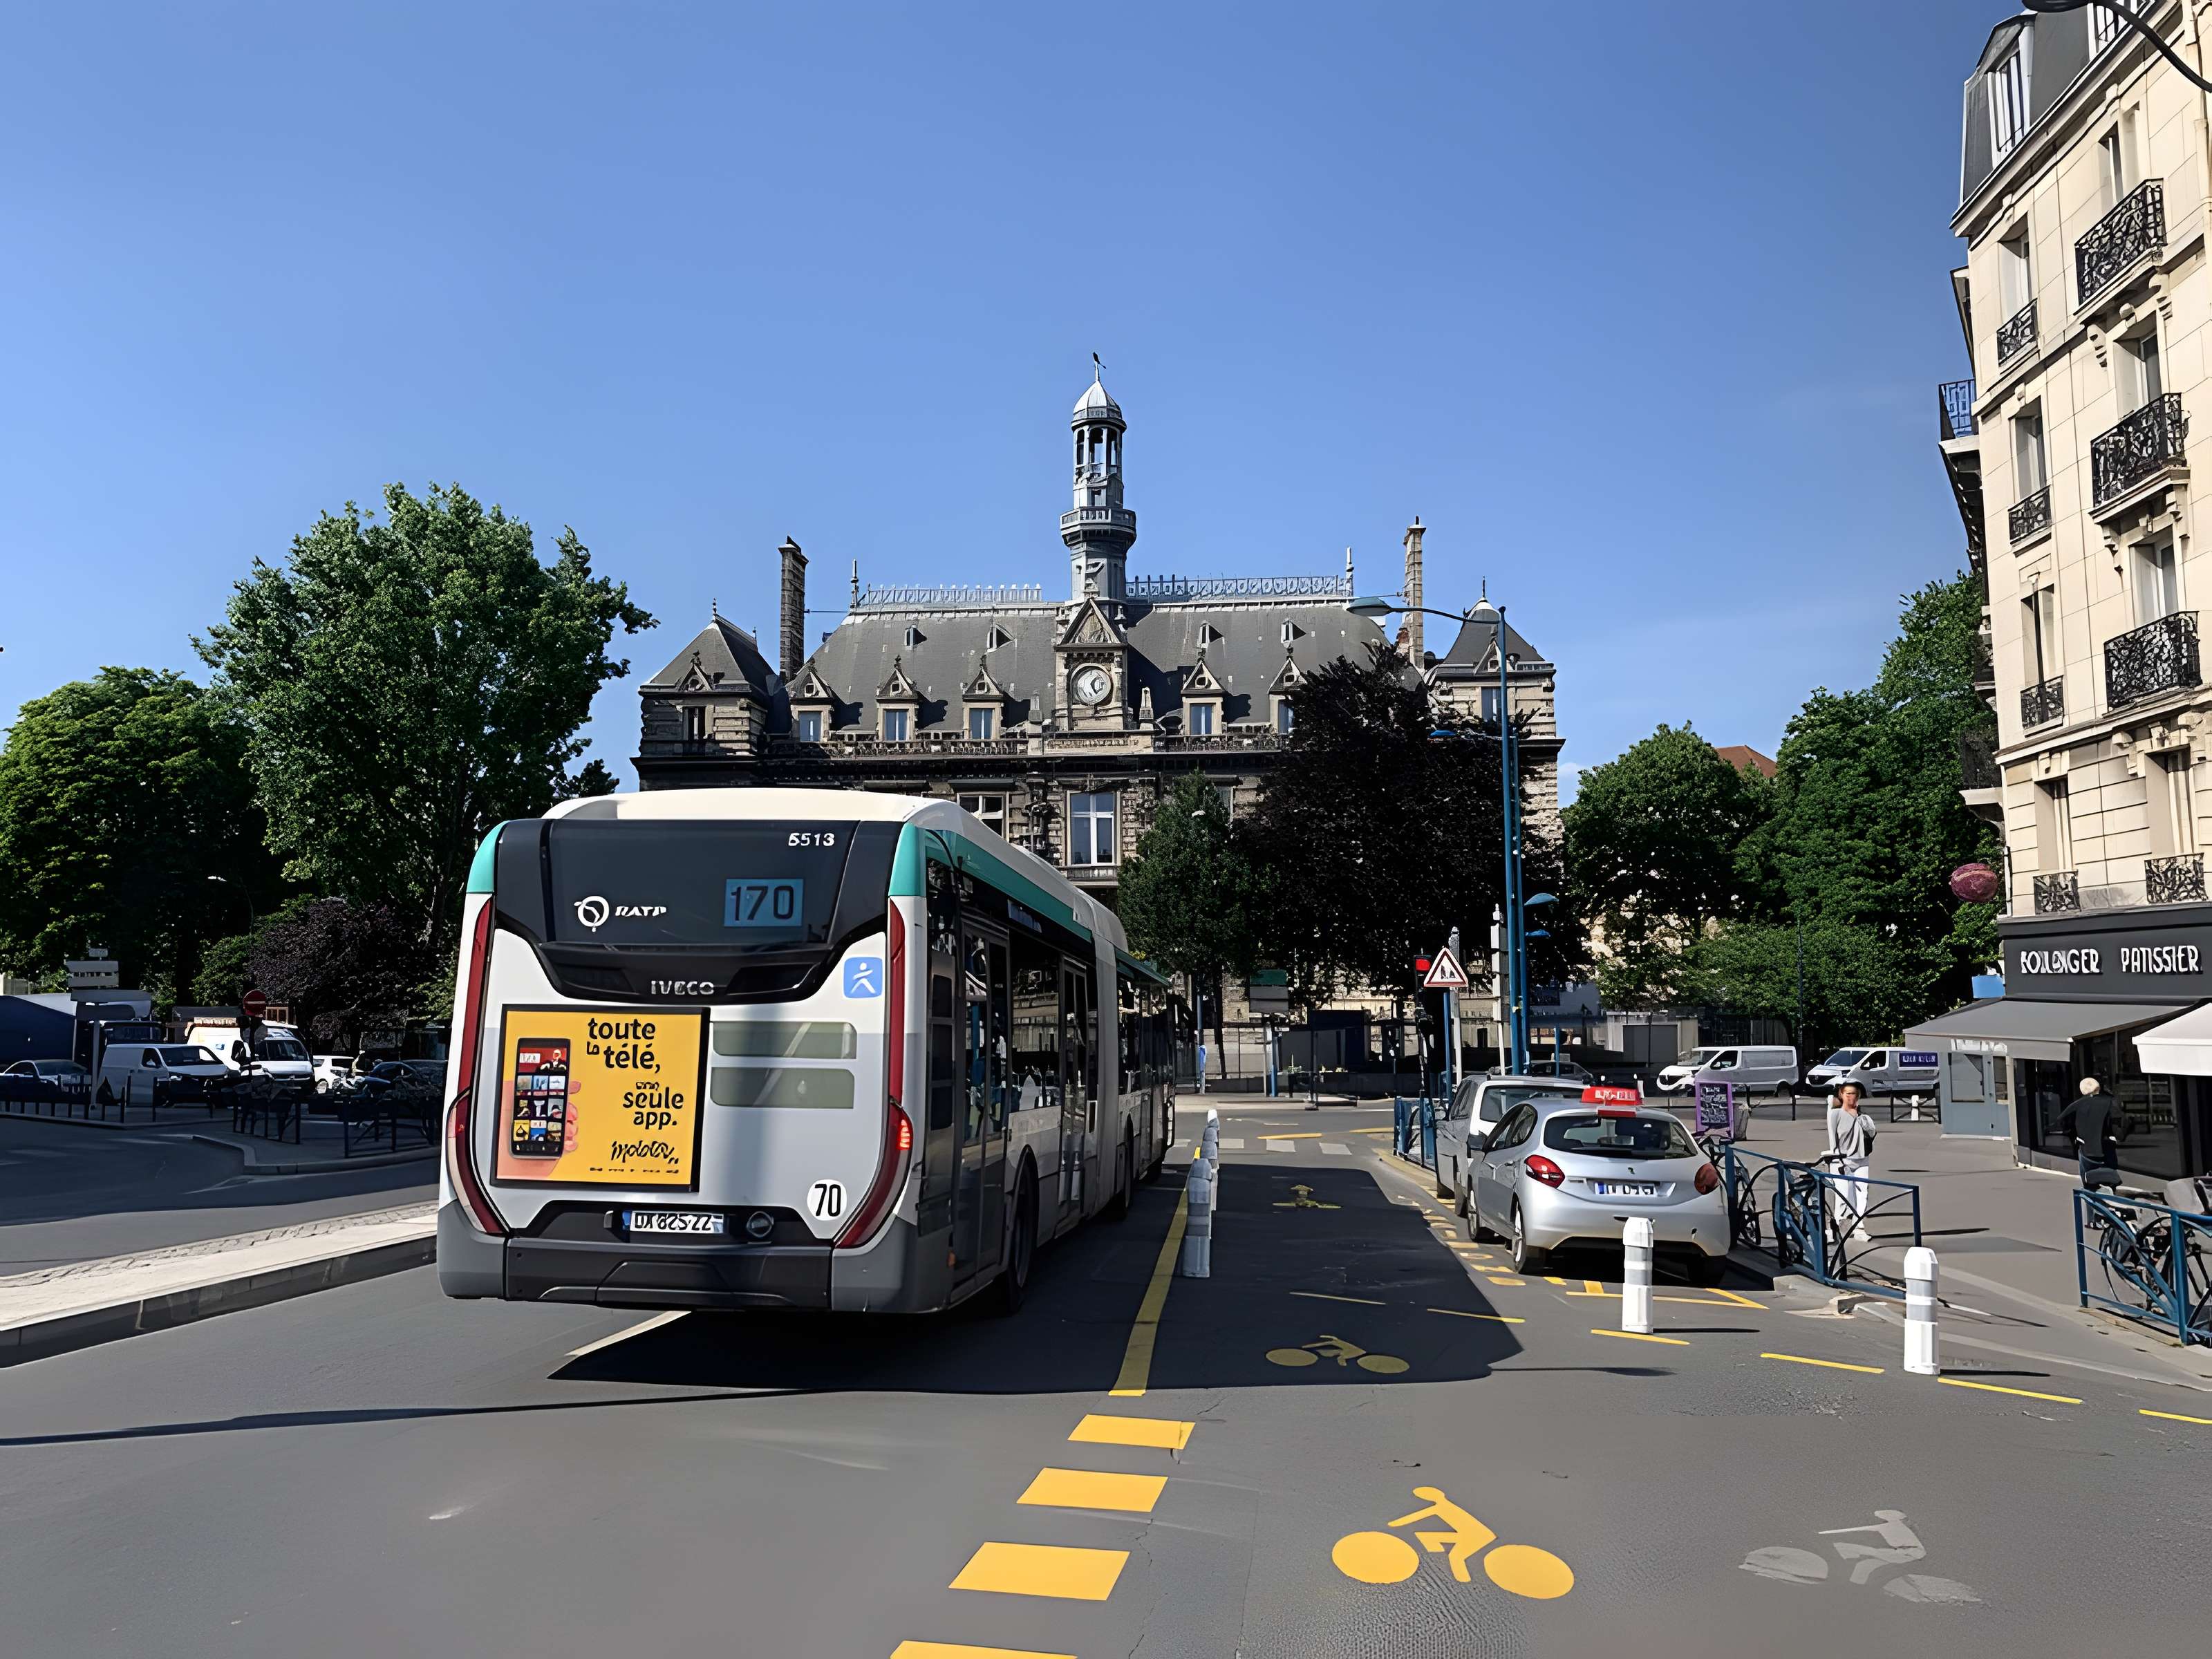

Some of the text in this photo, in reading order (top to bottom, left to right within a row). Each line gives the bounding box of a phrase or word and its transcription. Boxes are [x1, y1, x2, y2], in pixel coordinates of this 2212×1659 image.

[730, 885, 794, 921] 170
[651, 980, 714, 995] IVECO
[588, 1018, 656, 1040] toute
[603, 1043, 661, 1074] télé,
[623, 1087, 684, 1109] seule
[633, 1112, 677, 1130] app.
[814, 1183, 841, 1217] 70
